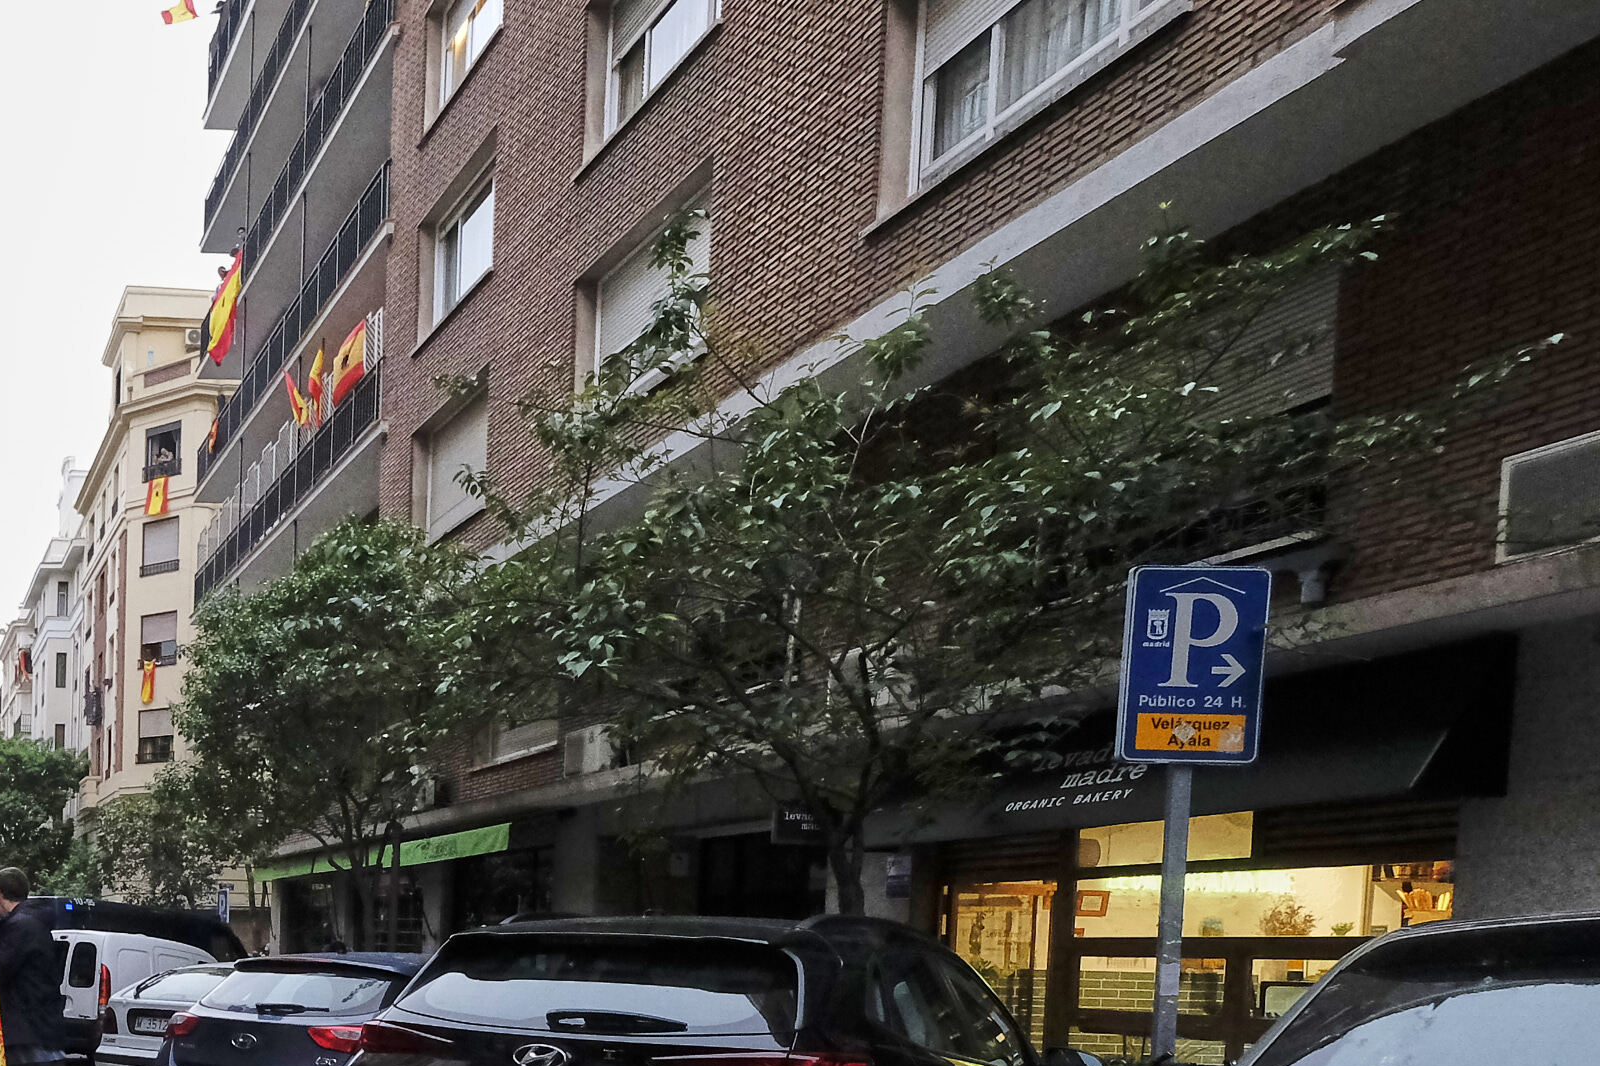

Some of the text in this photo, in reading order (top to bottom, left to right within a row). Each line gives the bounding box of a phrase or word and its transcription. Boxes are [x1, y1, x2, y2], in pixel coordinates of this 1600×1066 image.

[1157, 593, 1239, 687] P
[1138, 694, 1196, 708] Público
[1203, 695, 1224, 708] 24
[1060, 761, 1148, 789] madre
[1005, 788, 1134, 812] ORGANIC BAKERY
